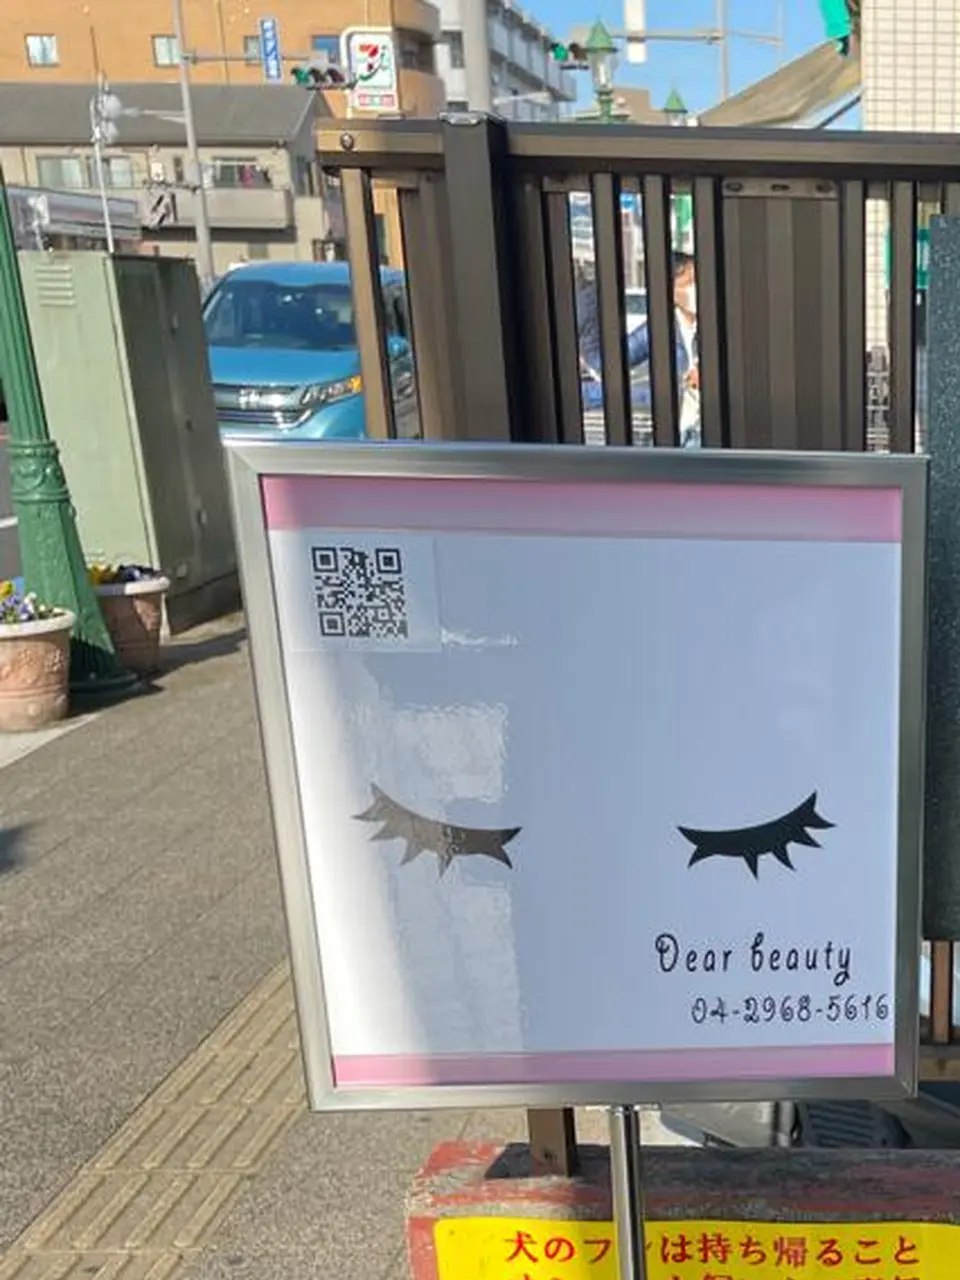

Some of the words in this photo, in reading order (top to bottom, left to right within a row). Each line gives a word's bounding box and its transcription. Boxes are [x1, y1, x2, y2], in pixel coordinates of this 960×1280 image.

[655, 933, 733, 973] Dear
[750, 931, 851, 986] beauty
[691, 994, 889, 1024] 04-2968-5616
[504, 1230, 919, 1267] 犬のフは持ち帰ること
